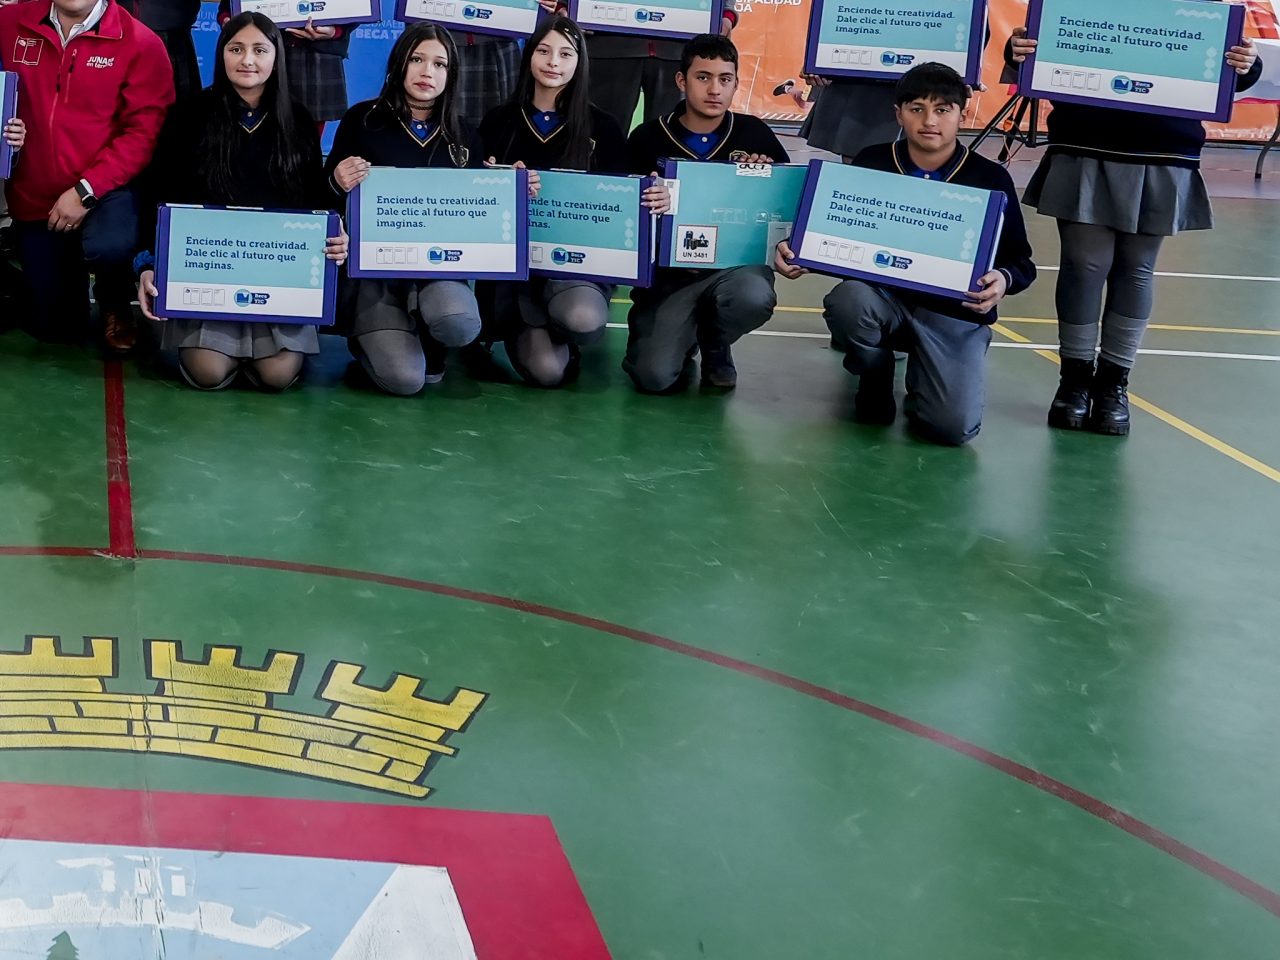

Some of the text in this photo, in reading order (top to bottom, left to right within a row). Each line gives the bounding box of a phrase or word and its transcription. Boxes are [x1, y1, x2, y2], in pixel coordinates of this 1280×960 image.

[838, 5, 882, 15] Enciende
[192, 22, 218, 32] ECA
[837, 15, 858, 23] Dale
[890, 18, 921, 27] futuro
[356, 29, 388, 39] BECA
[1059, 16, 1204, 40] Enciende tu creatividad.
[1058, 28, 1188, 51] Dale clic al futuro que
[1056, 40, 1113, 55] imaginas.
[376, 195, 424, 204] Enciende
[439, 197, 499, 205] creatividad.
[832, 190, 964, 222] Enciende tu creatividad.
[377, 207, 487, 218] Dale clic al futuro que
[829, 201, 949, 231] Dale clic al futuro que
[376, 219, 426, 229] imaginas.
[826, 212, 878, 230] imaginas.
[186, 236, 309, 250] Enciende tu creatividad.
[185, 248, 296, 262] Dale clic al futuro que
[185, 259, 234, 271] imaginas.
